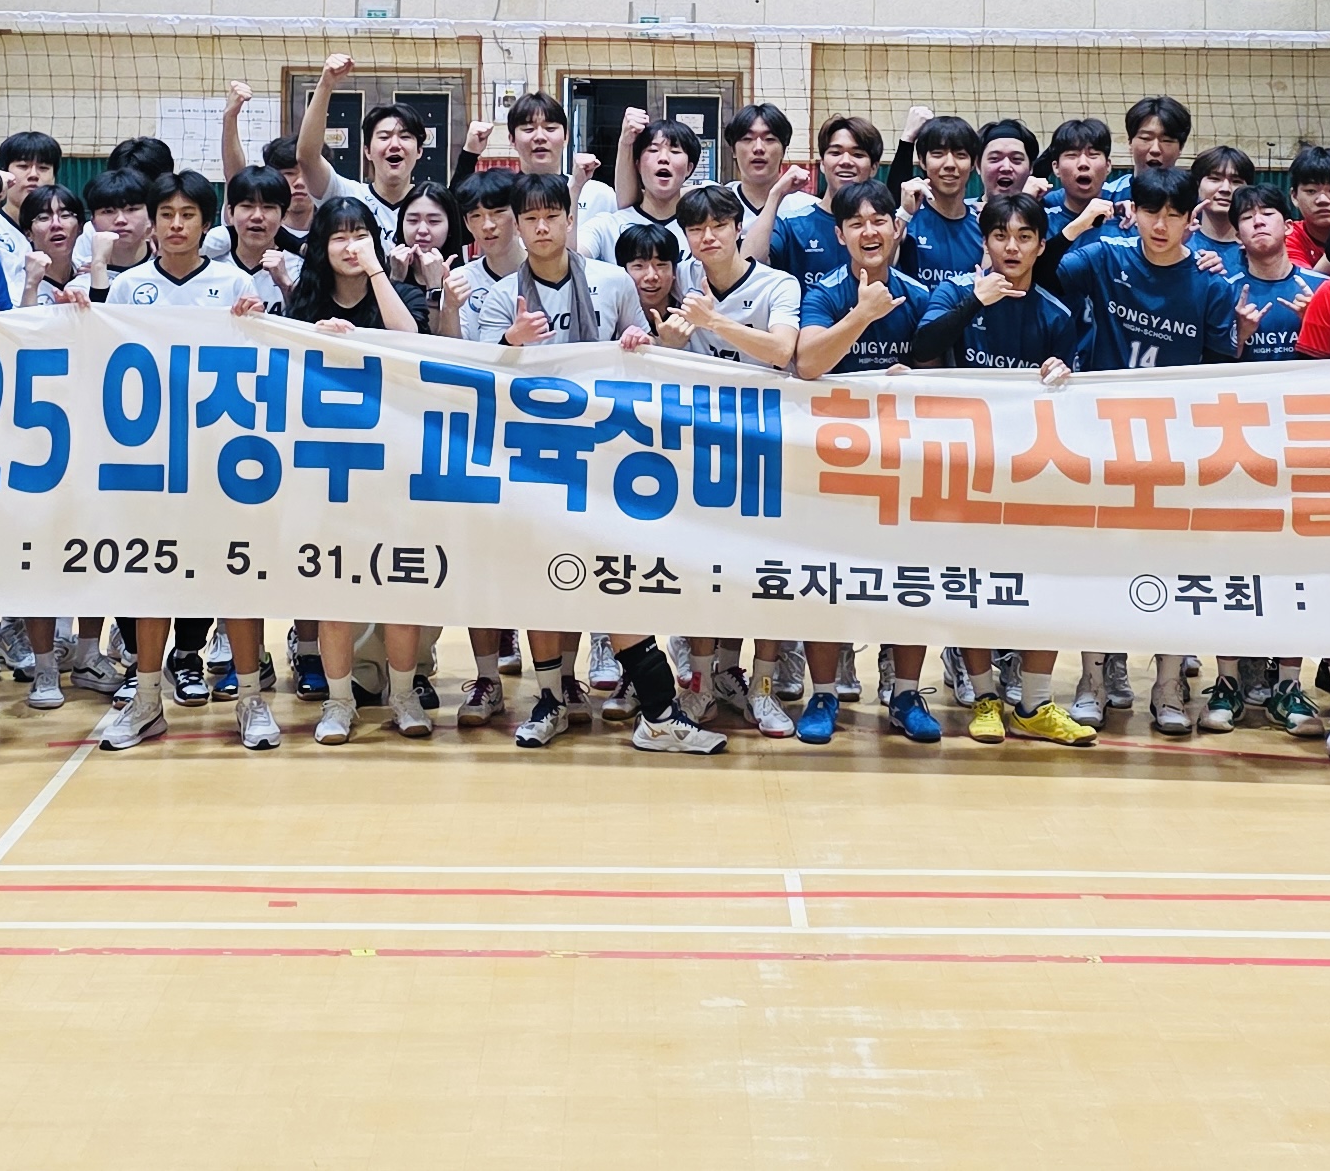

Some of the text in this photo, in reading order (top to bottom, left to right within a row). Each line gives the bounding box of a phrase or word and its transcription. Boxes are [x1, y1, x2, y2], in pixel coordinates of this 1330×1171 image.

[1107, 300, 1197, 338] SONGYANG
[1122, 322, 1174, 342] HIGH-SCHOOL
[1129, 341, 1159, 368] 14
[98, 342, 385, 505] 의정부
[409, 361, 782, 521] 교육장배
[63, 538, 195, 579] 2025.
[226, 541, 268, 580] 5.
[297, 543, 448, 589] 31.(토)
[593, 553, 682, 595] 장소
[752, 559, 1030, 608] 효자고등학교
[1175, 574, 1264, 616] 주최
